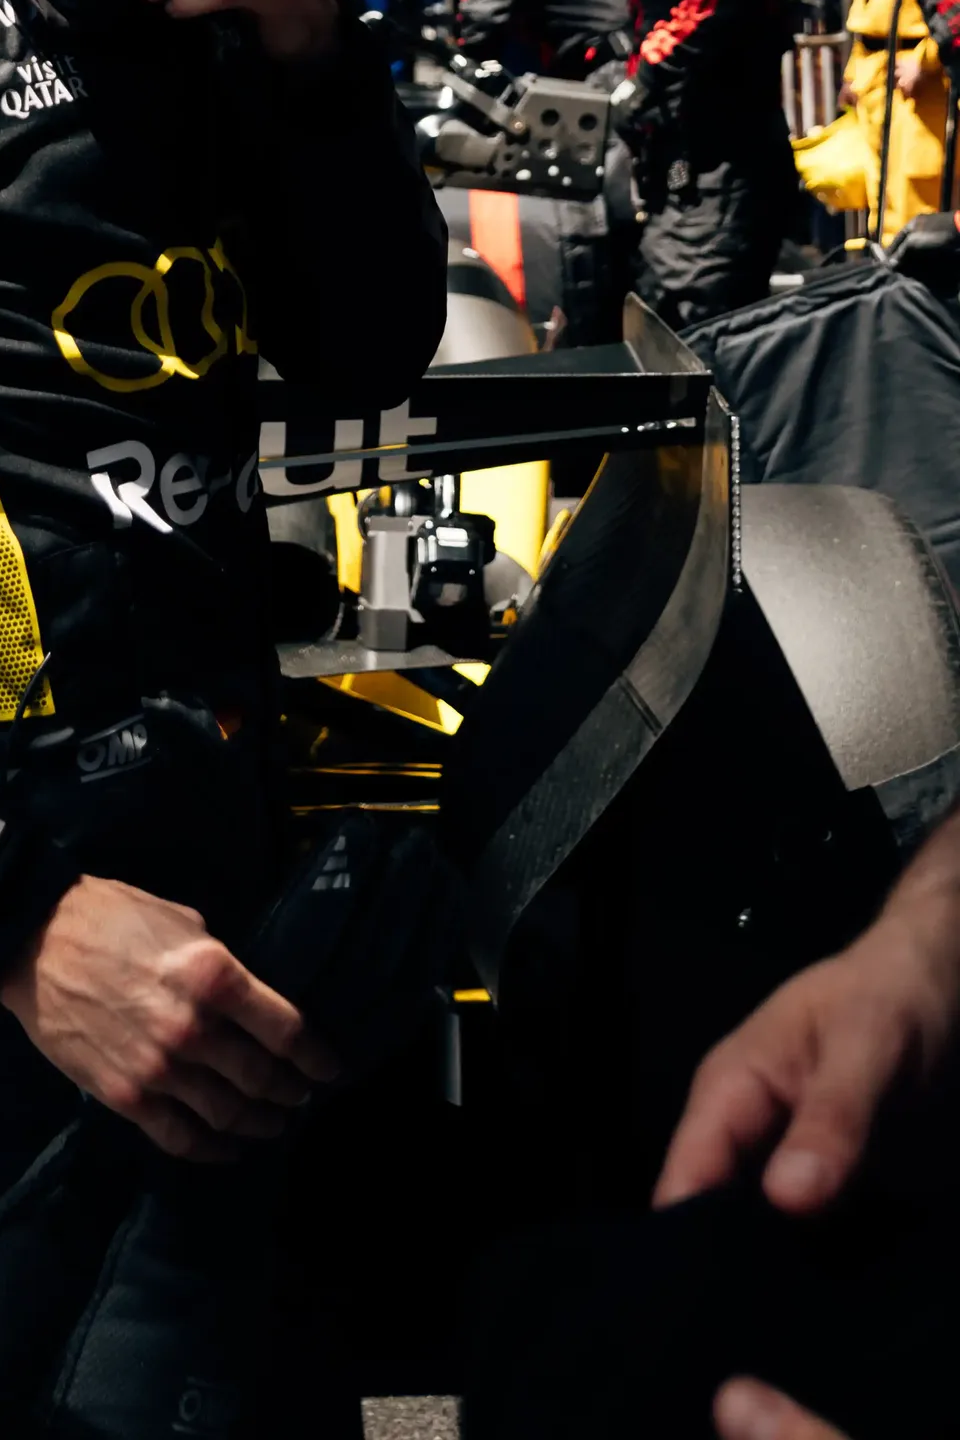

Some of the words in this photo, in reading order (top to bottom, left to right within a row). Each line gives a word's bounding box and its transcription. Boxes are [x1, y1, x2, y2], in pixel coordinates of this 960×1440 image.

[17, 54, 80, 84] visit
[1, 76, 89, 119] QATAR
[76, 722, 149, 773] OMP
